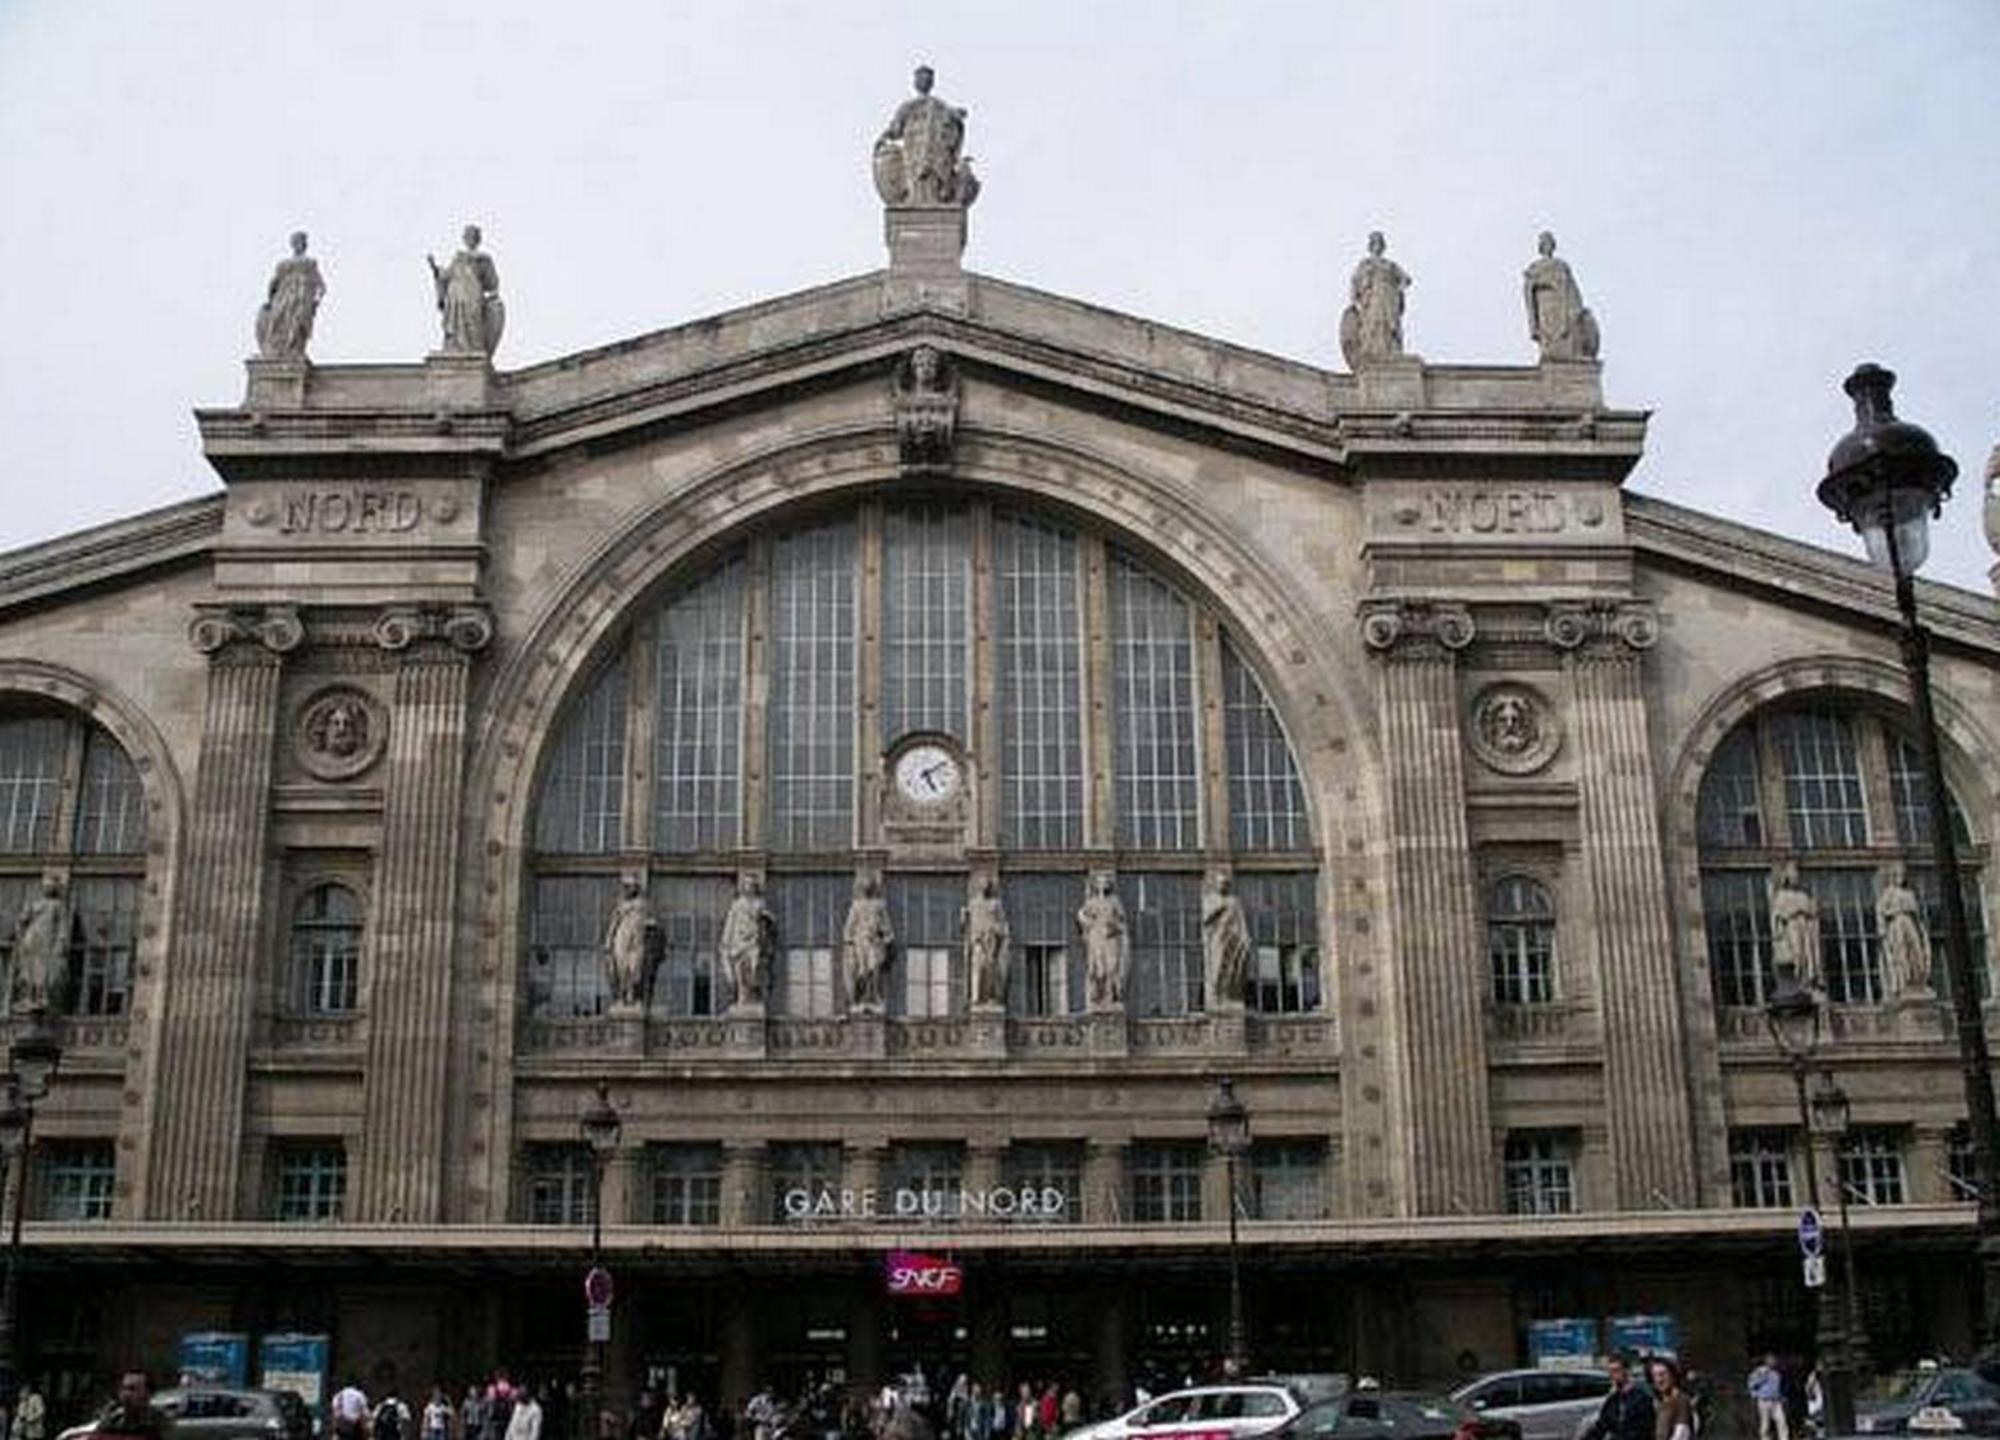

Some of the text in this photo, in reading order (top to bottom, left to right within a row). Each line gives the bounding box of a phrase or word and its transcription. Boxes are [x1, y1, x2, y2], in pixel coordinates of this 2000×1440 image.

[280, 491, 423, 534] NORD
[1424, 491, 1567, 533] NORD
[784, 1186, 1064, 1216] GARE DU NORD
[889, 1268, 960, 1289] SNCF
